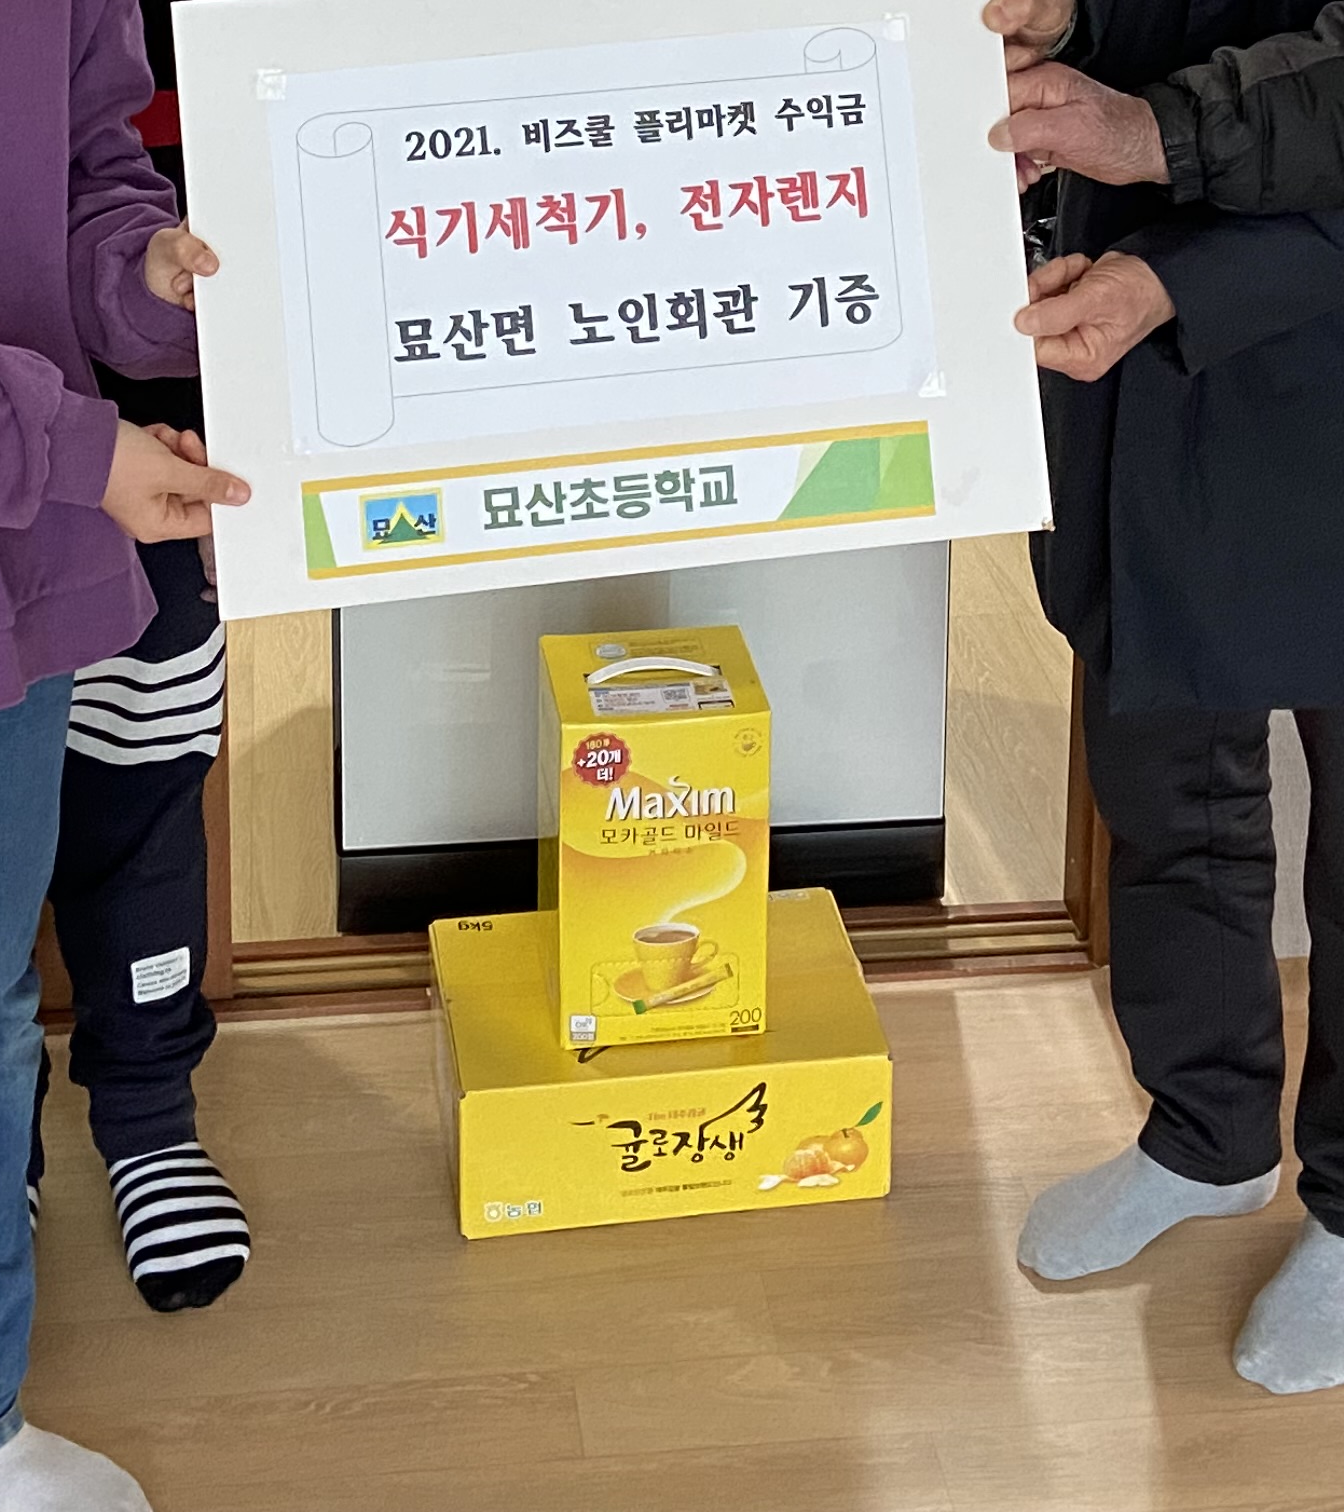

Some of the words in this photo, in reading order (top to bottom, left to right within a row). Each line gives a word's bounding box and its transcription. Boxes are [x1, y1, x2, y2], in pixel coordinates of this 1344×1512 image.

[405, 125, 502, 163] 2021.
[522, 114, 616, 154] 비즈쿨
[633, 99, 758, 145] 플리마켓
[775, 91, 867, 134] 수익금
[385, 186, 648, 260] 식기세척기,
[679, 166, 869, 234] 전자렌지
[393, 303, 536, 364] 묘산면
[568, 282, 759, 347] 노인회관
[788, 272, 881, 329] 기증
[482, 464, 739, 531] 묘산초등학교
[605, 776, 736, 822] Maxim
[600, 825, 678, 846] 모카골드
[684, 820, 741, 841] 마일드
[730, 1007, 762, 1026] 200
